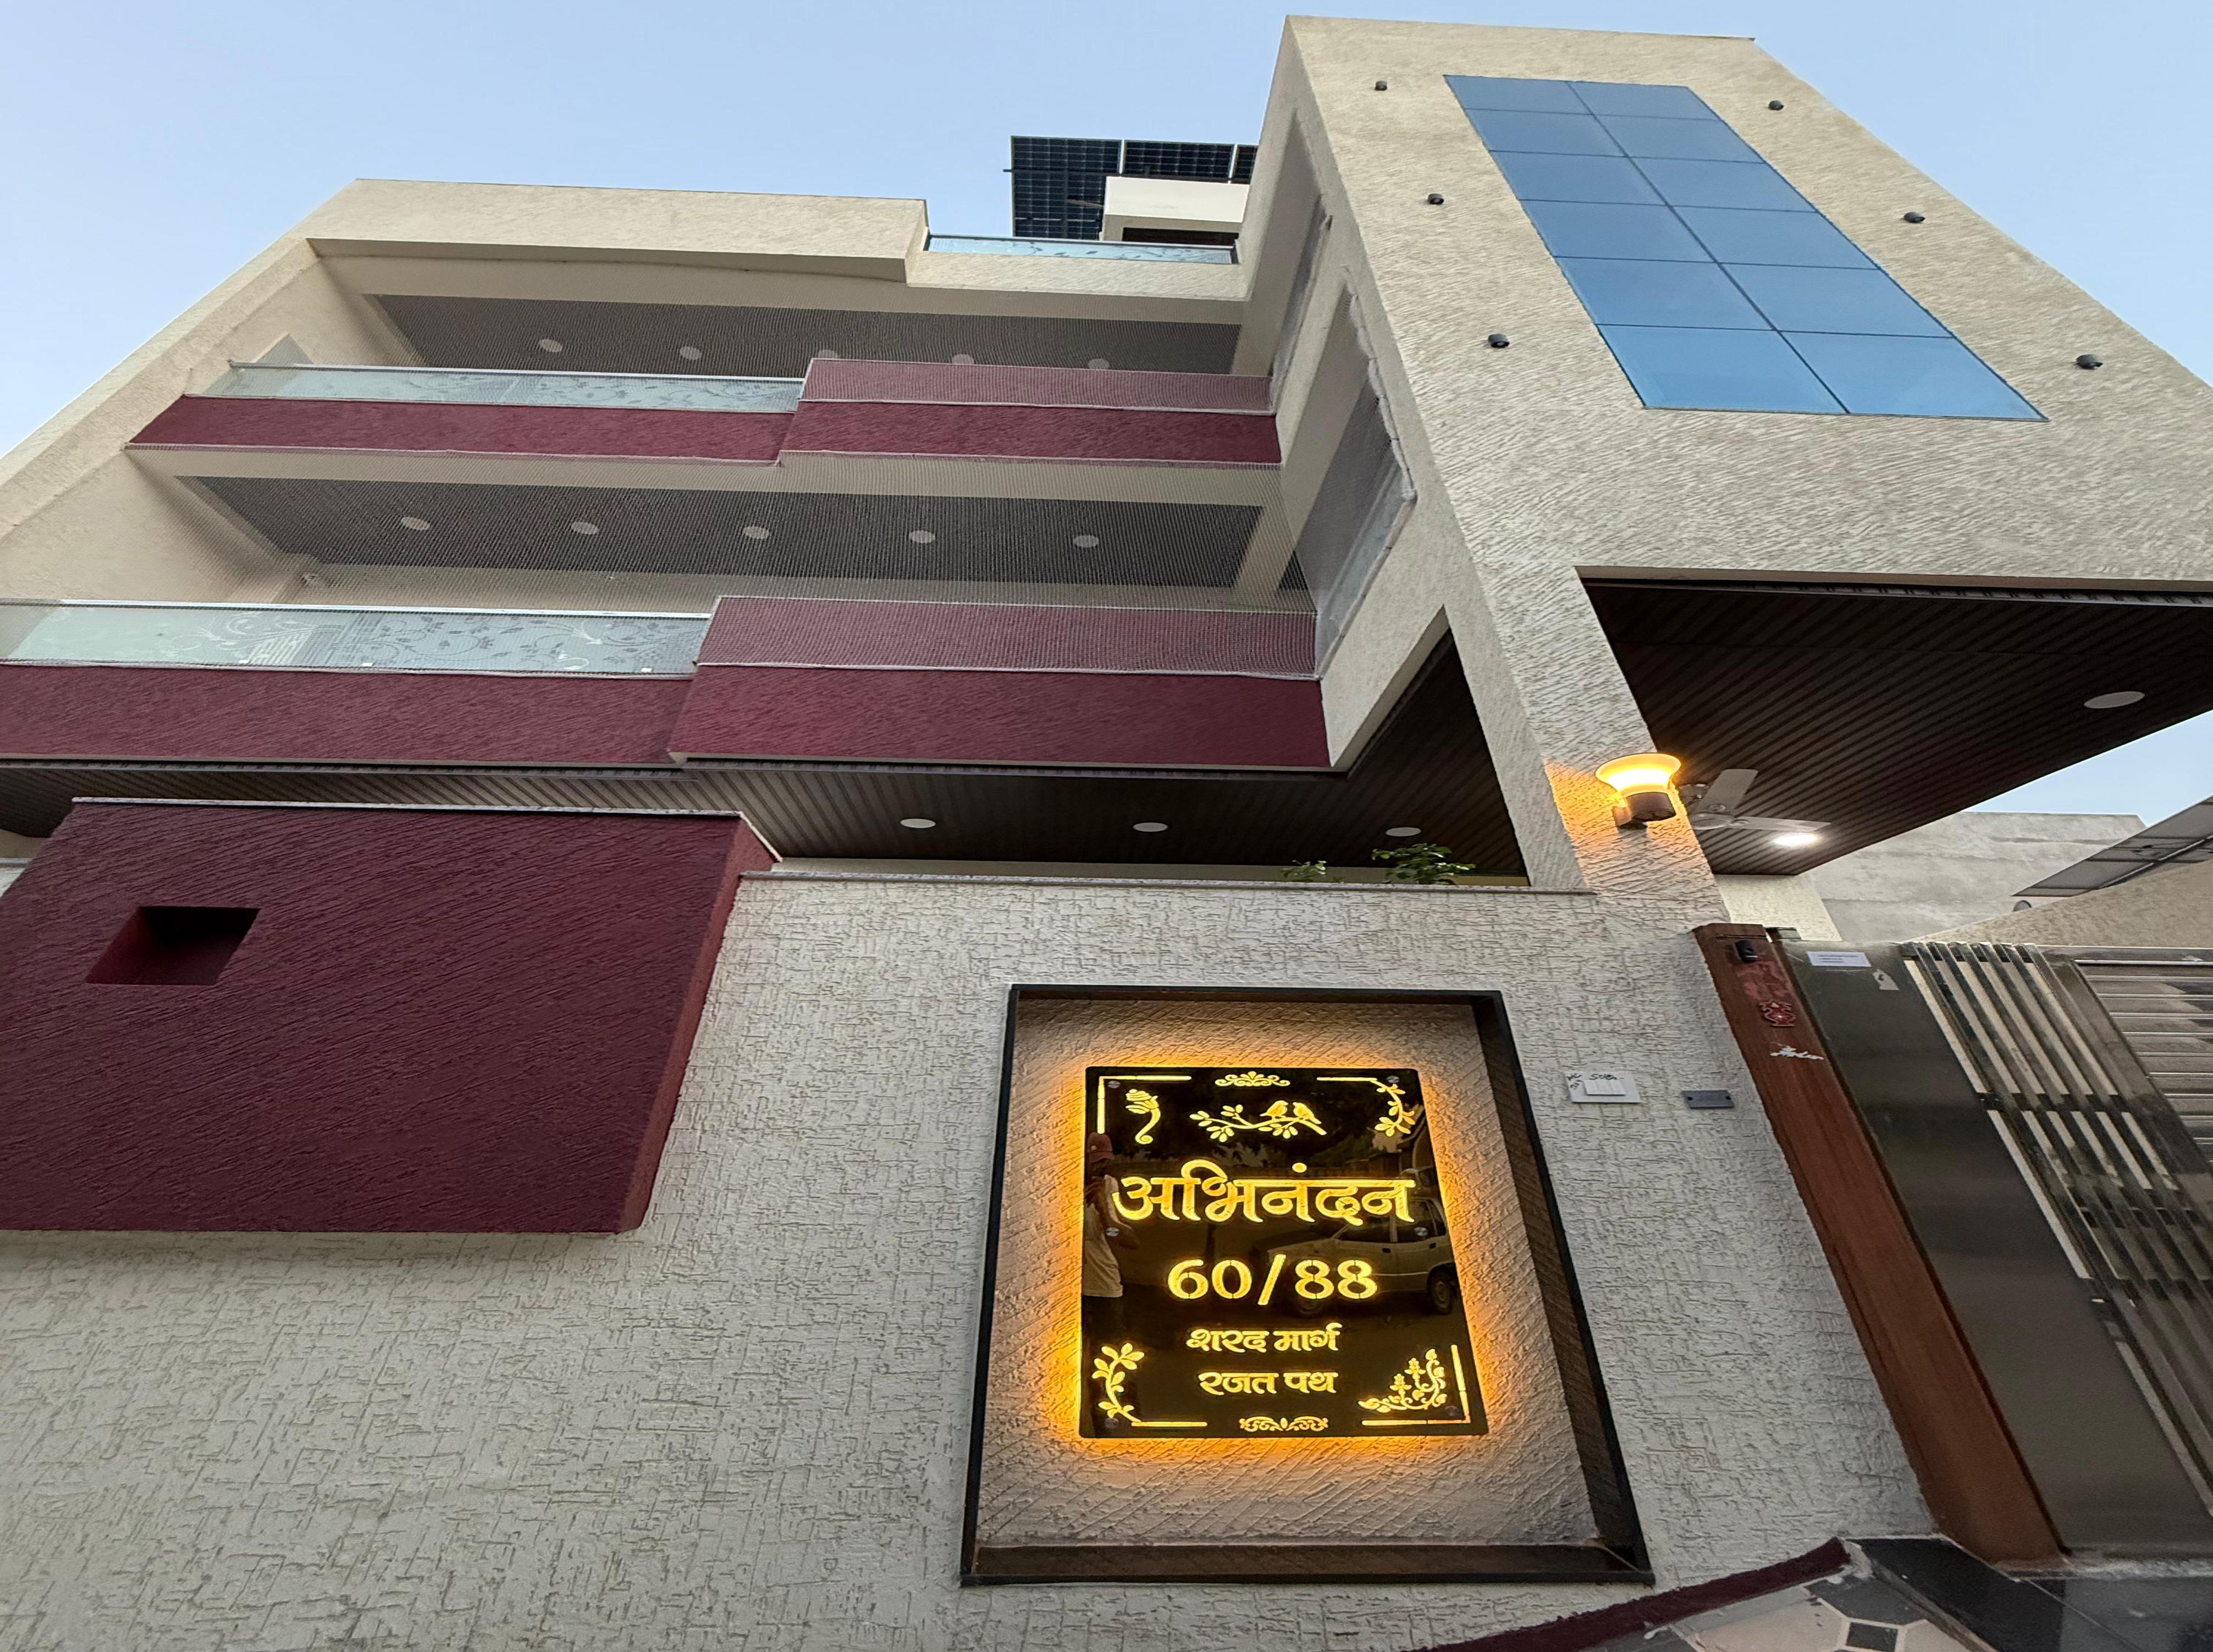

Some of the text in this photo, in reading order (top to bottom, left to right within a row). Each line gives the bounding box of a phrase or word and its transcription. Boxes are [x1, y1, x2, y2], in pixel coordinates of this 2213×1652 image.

[1112, 1159, 1416, 1226] अभिनंदन
[1168, 1254, 1377, 1306] 60/88
[1186, 1322, 1343, 1353] शरद मार्ग
[1198, 1372, 1339, 1395] रजत पथ
